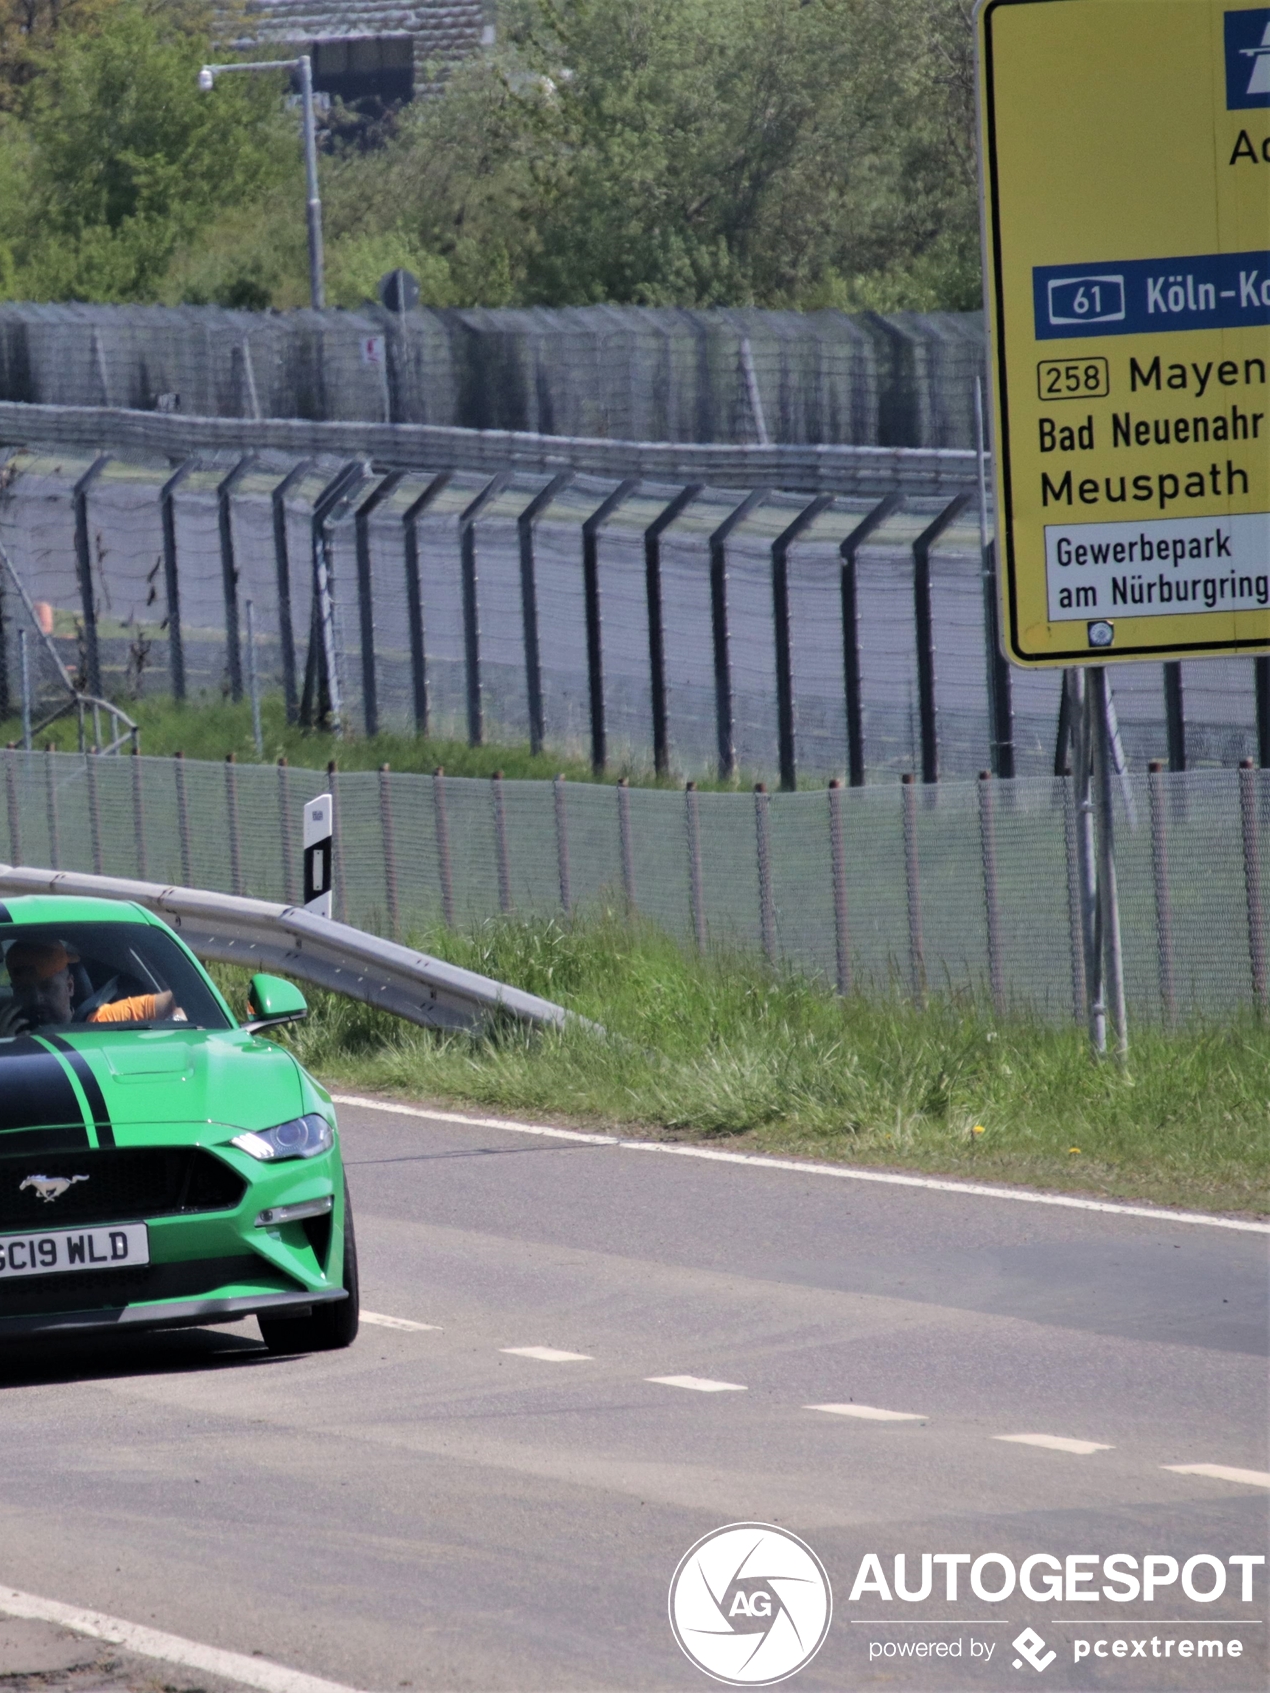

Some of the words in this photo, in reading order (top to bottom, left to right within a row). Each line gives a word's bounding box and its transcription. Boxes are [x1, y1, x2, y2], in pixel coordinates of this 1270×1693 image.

[1073, 286, 1101, 314] 61
[1046, 365, 1101, 393] 258
[1130, 356, 1266, 398] Mayen
[1039, 414, 1095, 452] Bad
[1112, 405, 1264, 448] Neuenahr
[1041, 460, 1249, 509] Meuspath
[1057, 529, 1232, 567] Gewerbepark
[1059, 585, 1097, 608] am
[1112, 570, 1269, 608] Nürburgring
[66, 1231, 128, 1264] WLD
